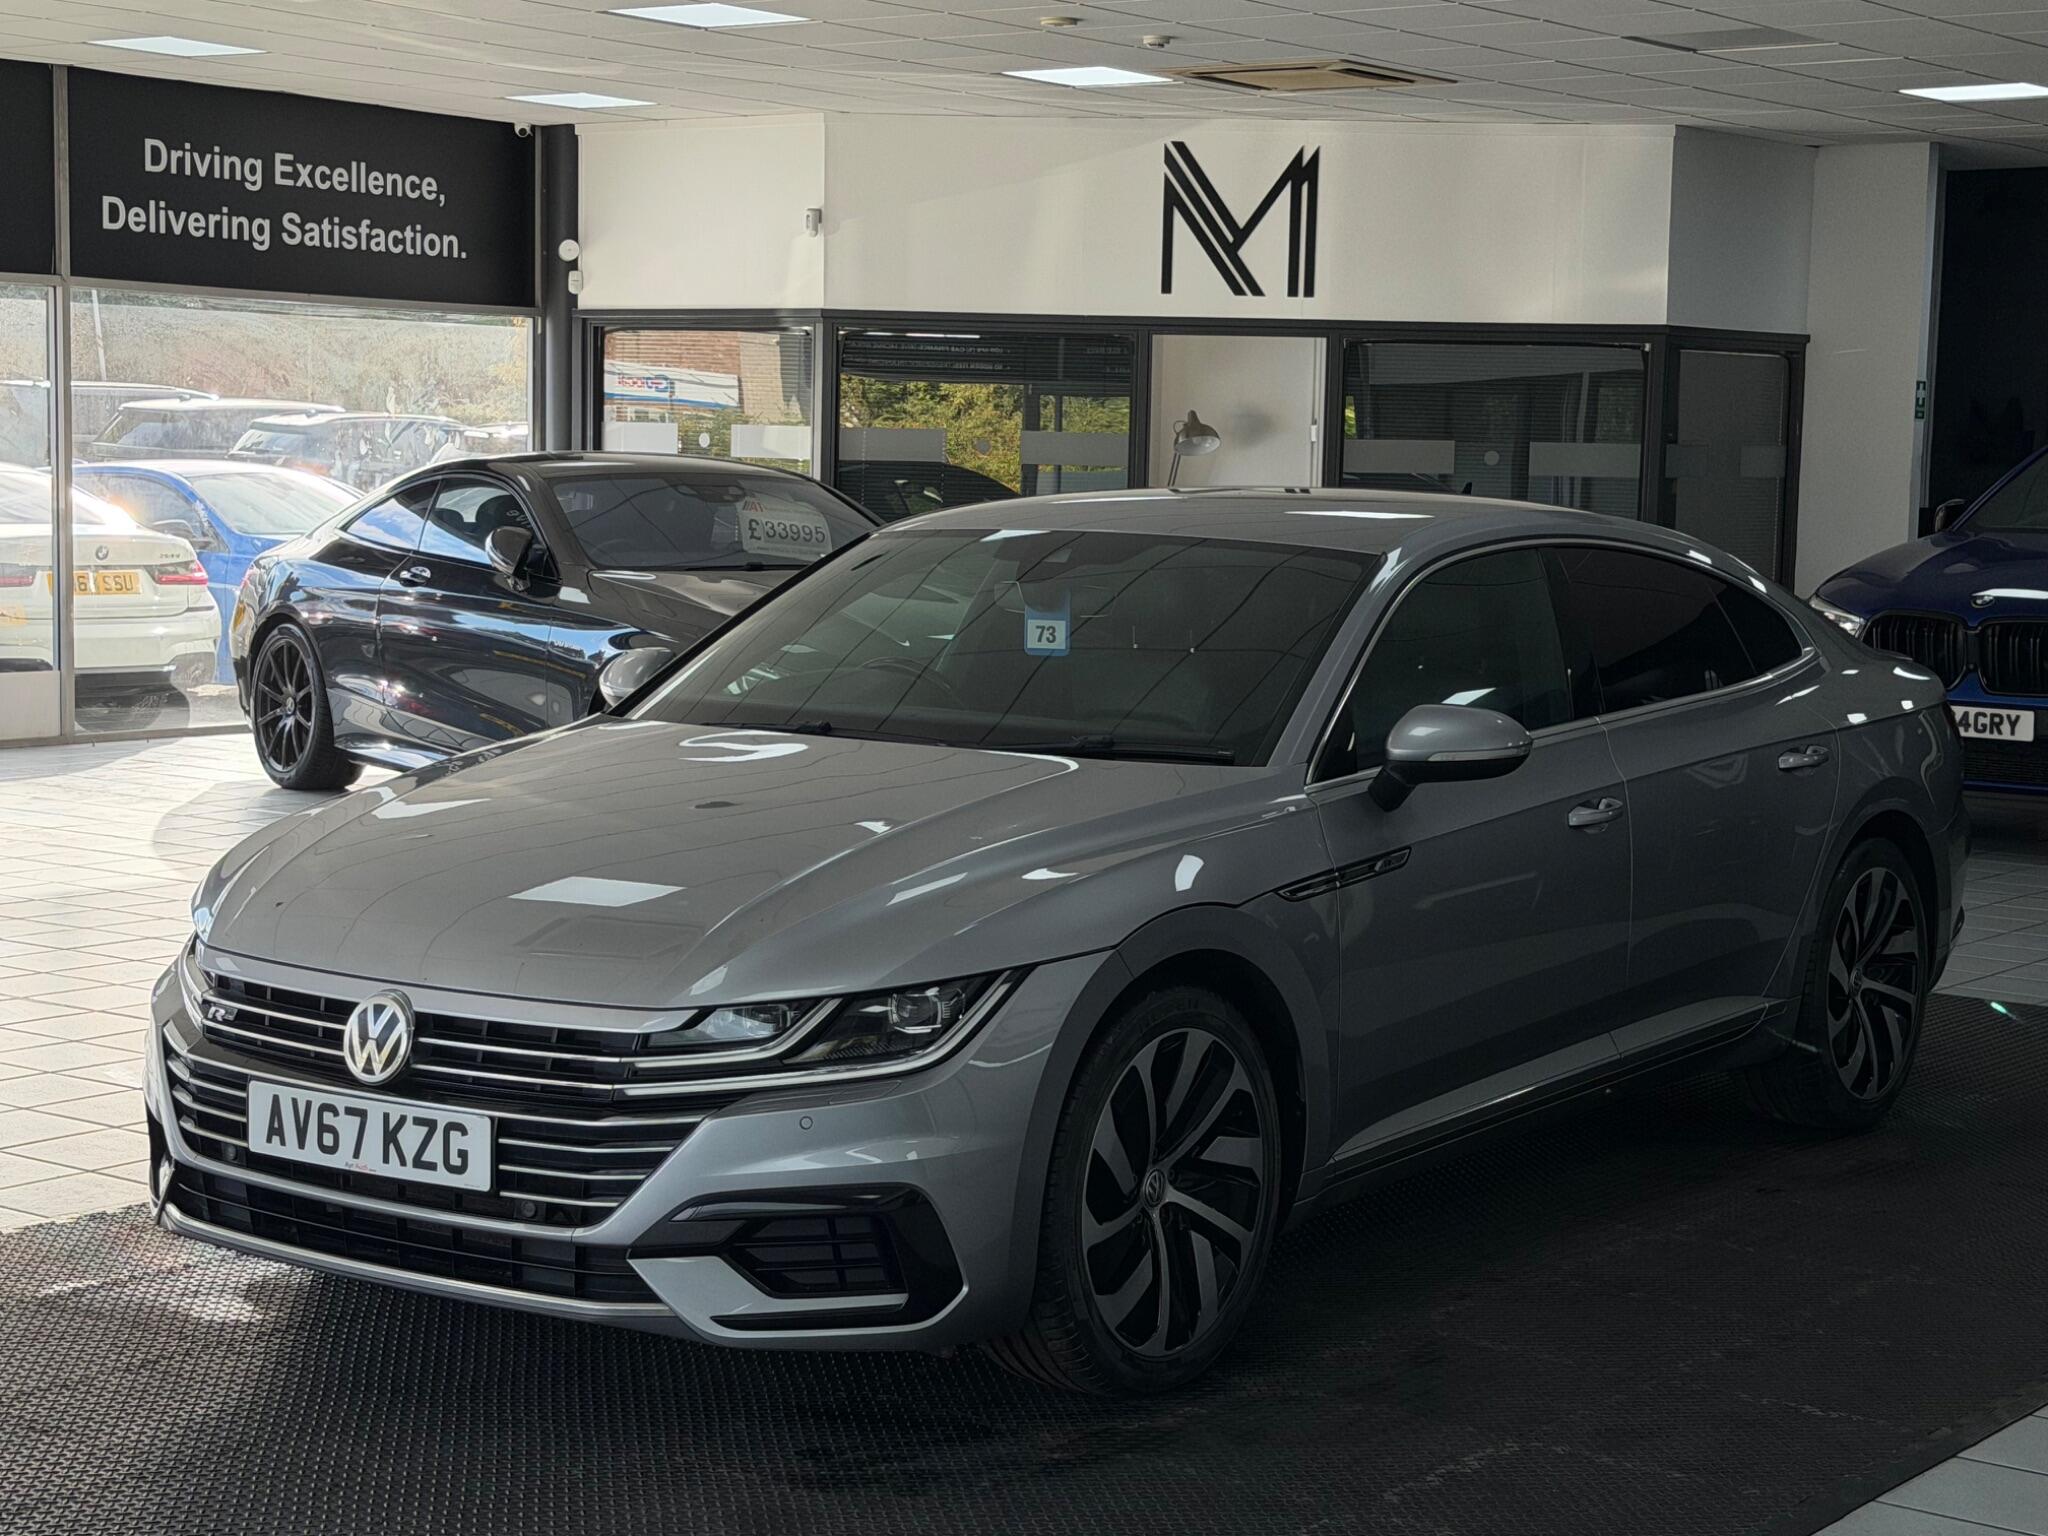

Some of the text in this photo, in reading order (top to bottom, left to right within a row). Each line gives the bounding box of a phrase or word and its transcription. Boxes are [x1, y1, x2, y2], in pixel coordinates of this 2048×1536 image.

[144, 138, 446, 207] Driving Excellence,
[102, 196, 468, 260] Delivering Satisfaction.
[748, 518, 826, 544] £33995
[1035, 625, 1057, 644] 73
[265, 1094, 469, 1176] AV67 KZG
